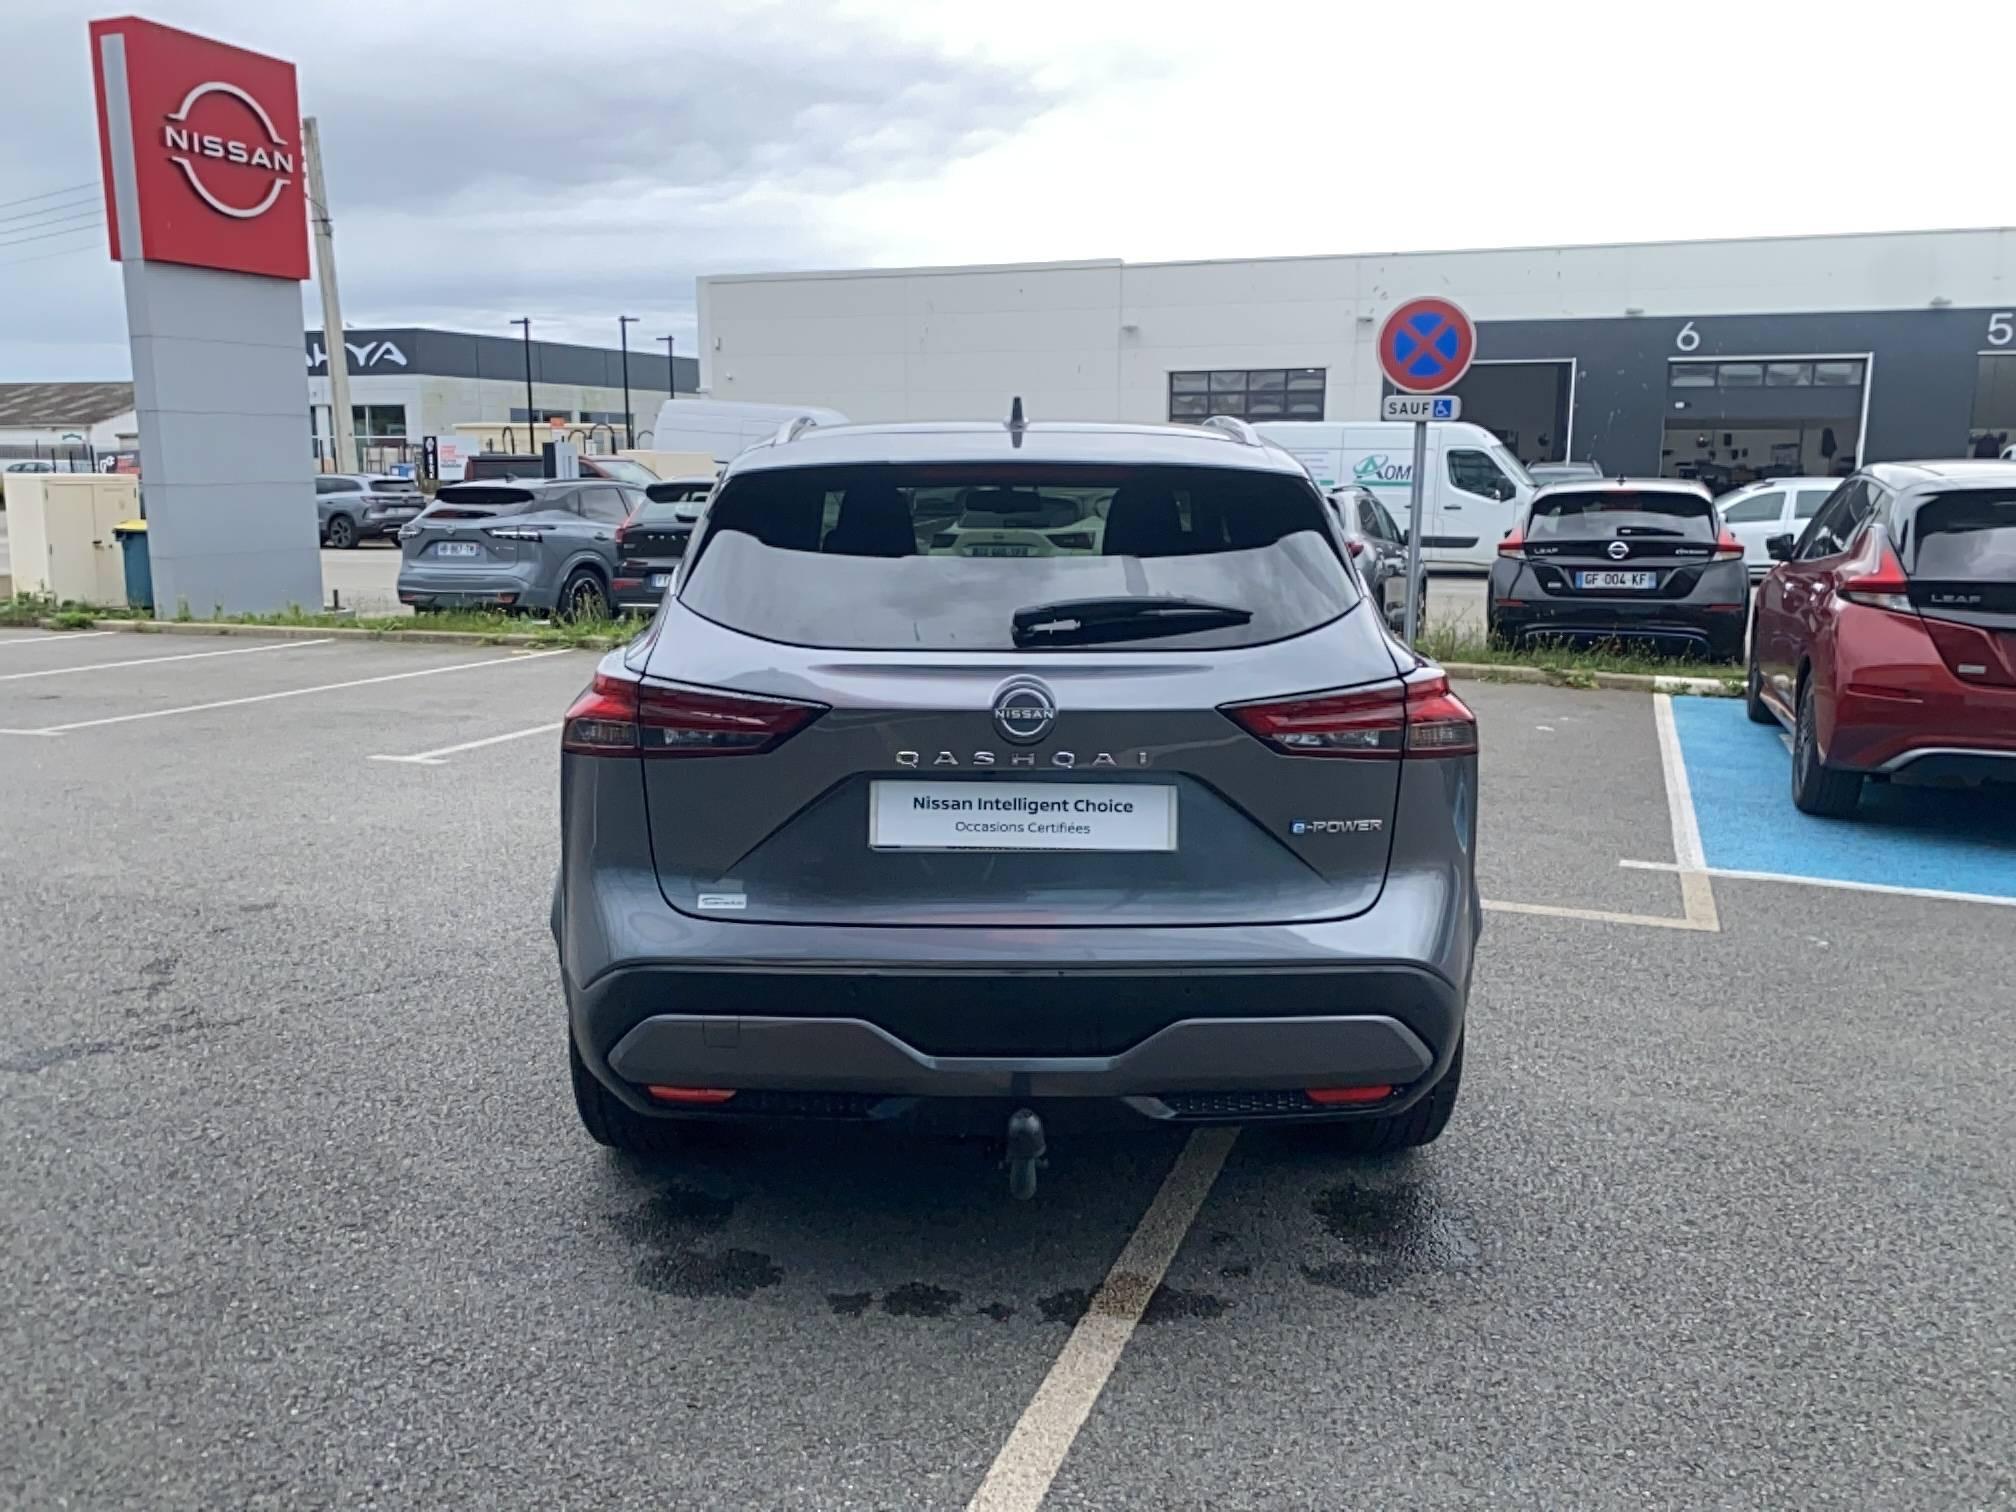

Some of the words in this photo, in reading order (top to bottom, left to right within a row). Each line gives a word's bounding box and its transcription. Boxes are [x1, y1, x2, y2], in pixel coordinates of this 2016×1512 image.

[164, 125, 293, 174] NISSAN
[1676, 320, 1701, 352] 6
[1986, 312, 2014, 346] 5
[1388, 401, 1430, 416] SAUF
[1584, 573, 1600, 585] GF
[1604, 573, 1626, 585] 004
[1631, 573, 1648, 585] KF
[1931, 594, 1982, 604] LEAF
[994, 707, 1054, 720] NISSAN
[895, 750, 1148, 768] QASHQAI
[913, 796, 972, 812] Nissan
[977, 797, 1069, 815] Intelligent
[1074, 799, 1133, 814] Choice
[955, 820, 1025, 834] Occasions
[1028, 821, 1091, 835] Certifiées
[1292, 819, 1383, 834] e-POWER
